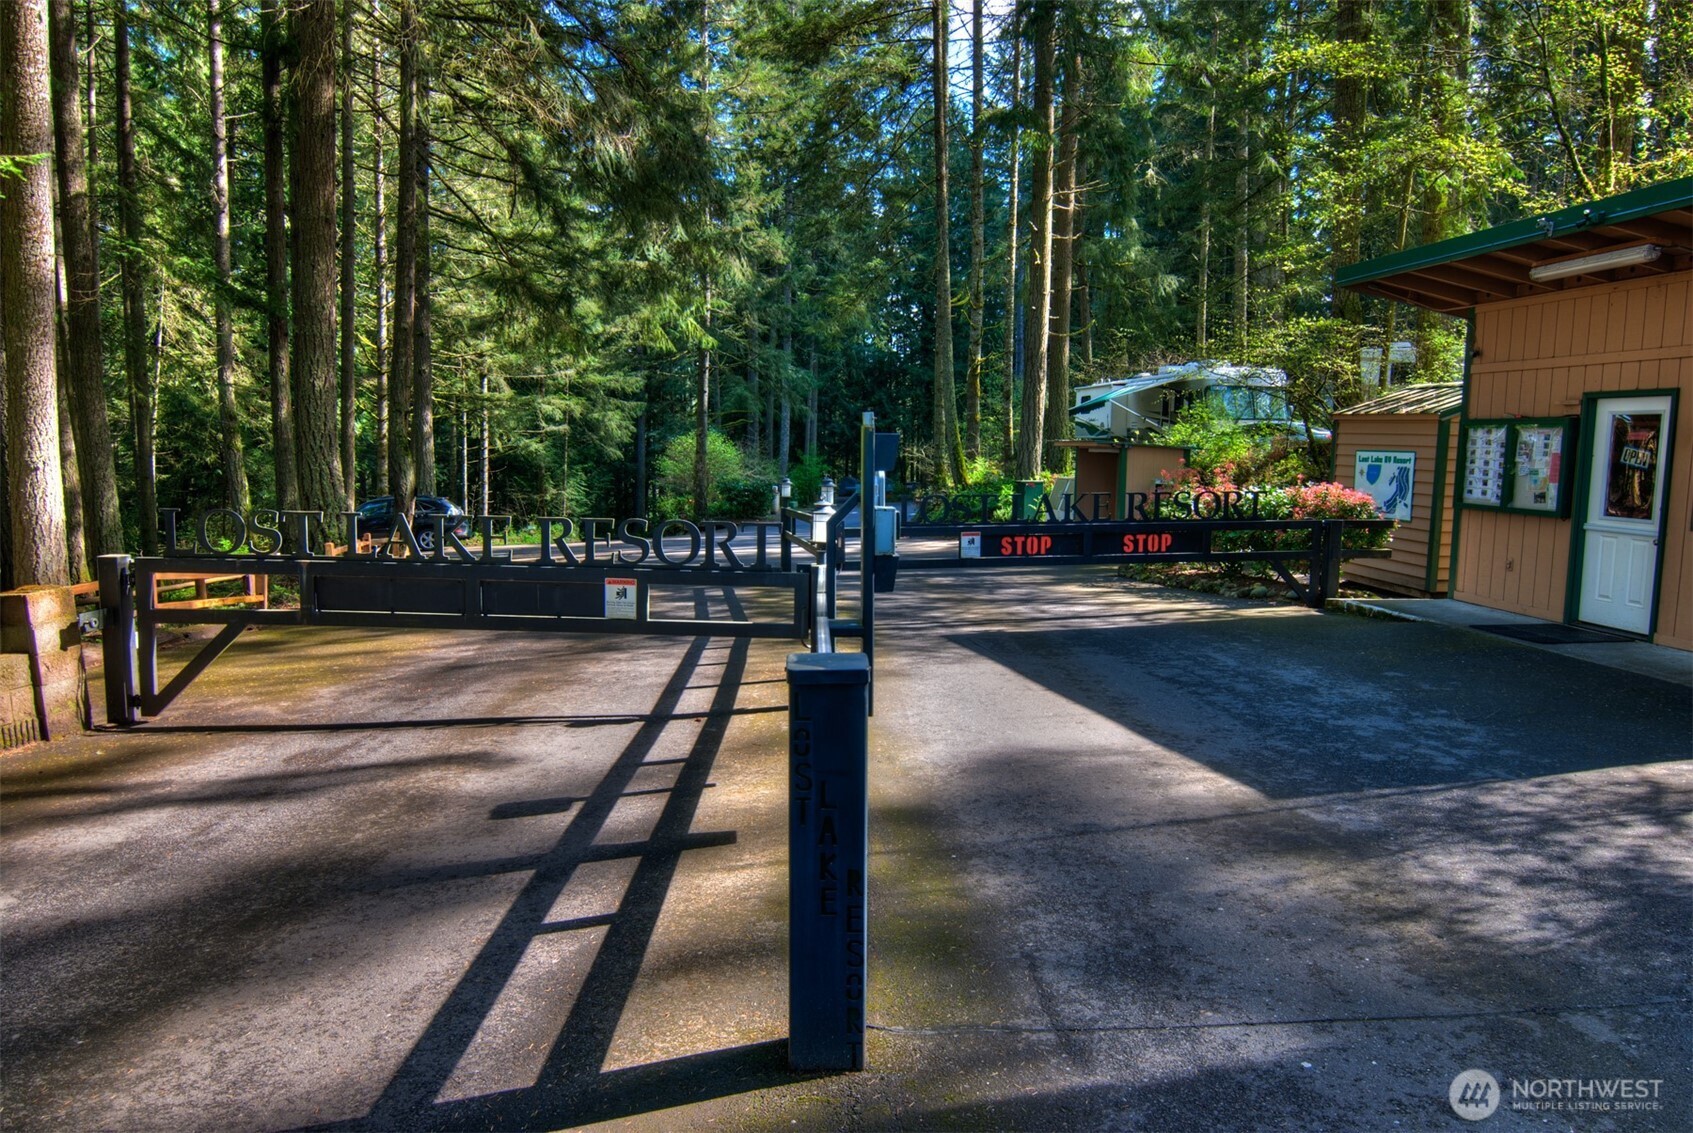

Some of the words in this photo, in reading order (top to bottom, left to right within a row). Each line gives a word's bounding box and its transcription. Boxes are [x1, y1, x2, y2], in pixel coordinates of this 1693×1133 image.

[1393, 456, 1411, 464] Resort
[1623, 447, 1649, 467] OPEN
[1010, 492, 1112, 524] LAKE
[1125, 490, 1268, 523] RESORT
[159, 507, 324, 558] LOST
[341, 511, 514, 564] LAKE
[536, 517, 784, 572] RESORT
[1001, 536, 1052, 556] STOP
[1123, 533, 1173, 553] STOP
[794, 692, 813, 826] LOST
[818, 779, 838, 917] LAKE
[845, 867, 864, 1071] RESORT
